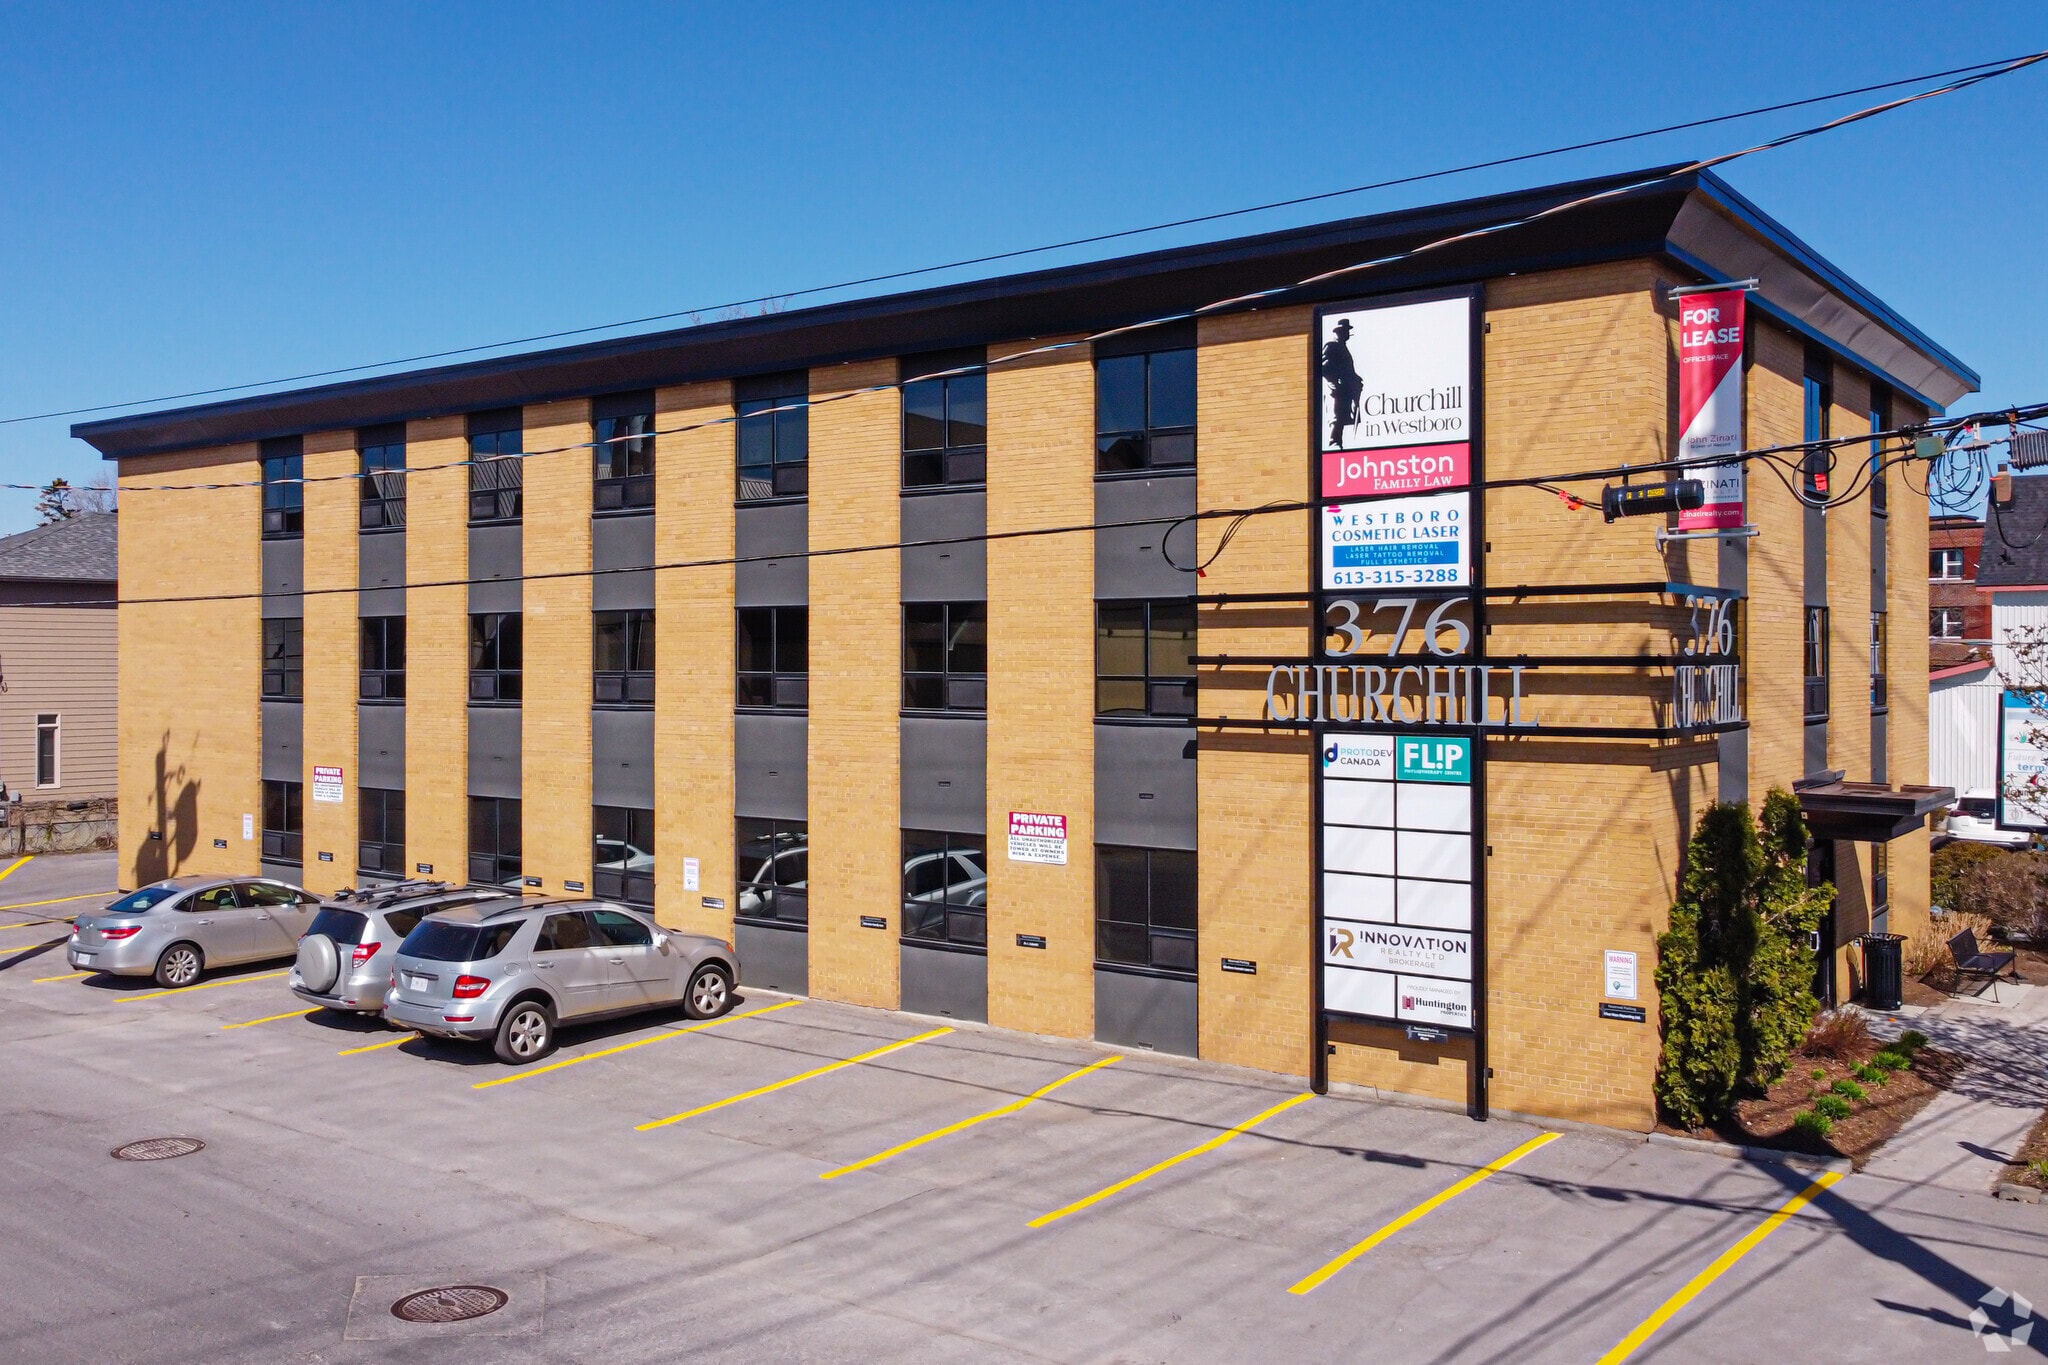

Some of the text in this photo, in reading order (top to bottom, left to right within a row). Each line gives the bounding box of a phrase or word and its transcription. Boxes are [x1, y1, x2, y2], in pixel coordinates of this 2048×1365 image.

[1683, 307, 1720, 326] FOR
[1683, 327, 1740, 348] LEASE
[1683, 352, 1729, 364] OFFICE SPACE
[1364, 386, 1463, 418] Churchill
[1365, 416, 1462, 437] in Westboro
[1337, 455, 1454, 487] Johnston
[1374, 475, 1453, 490] FAMILY LAW
[1333, 509, 1459, 526] WESTBORO
[1332, 526, 1459, 542] COSMETIC LASER
[1346, 552, 1370, 560] LASER
[1406, 550, 1444, 558] REMOVAL
[1378, 544, 1398, 552] HAIR
[1333, 568, 1458, 585] 613-315-3288
[1324, 597, 1470, 657] 376
[1684, 594, 1732, 656] 376
[1266, 664, 1539, 728] CHURCHILL
[1340, 757, 1381, 766] CANADA
[314, 775, 342, 784] PARKING
[315, 768, 341, 776] PRIVATE
[1012, 813, 1062, 826] PRIVATE
[1011, 824, 1064, 838] PARKING
[1380, 948, 1445, 961] REALTY LTD
[1608, 956, 1632, 964] WARNING
[1388, 958, 1436, 969] BROKERAGE
[1416, 997, 1467, 1012] Huntington
